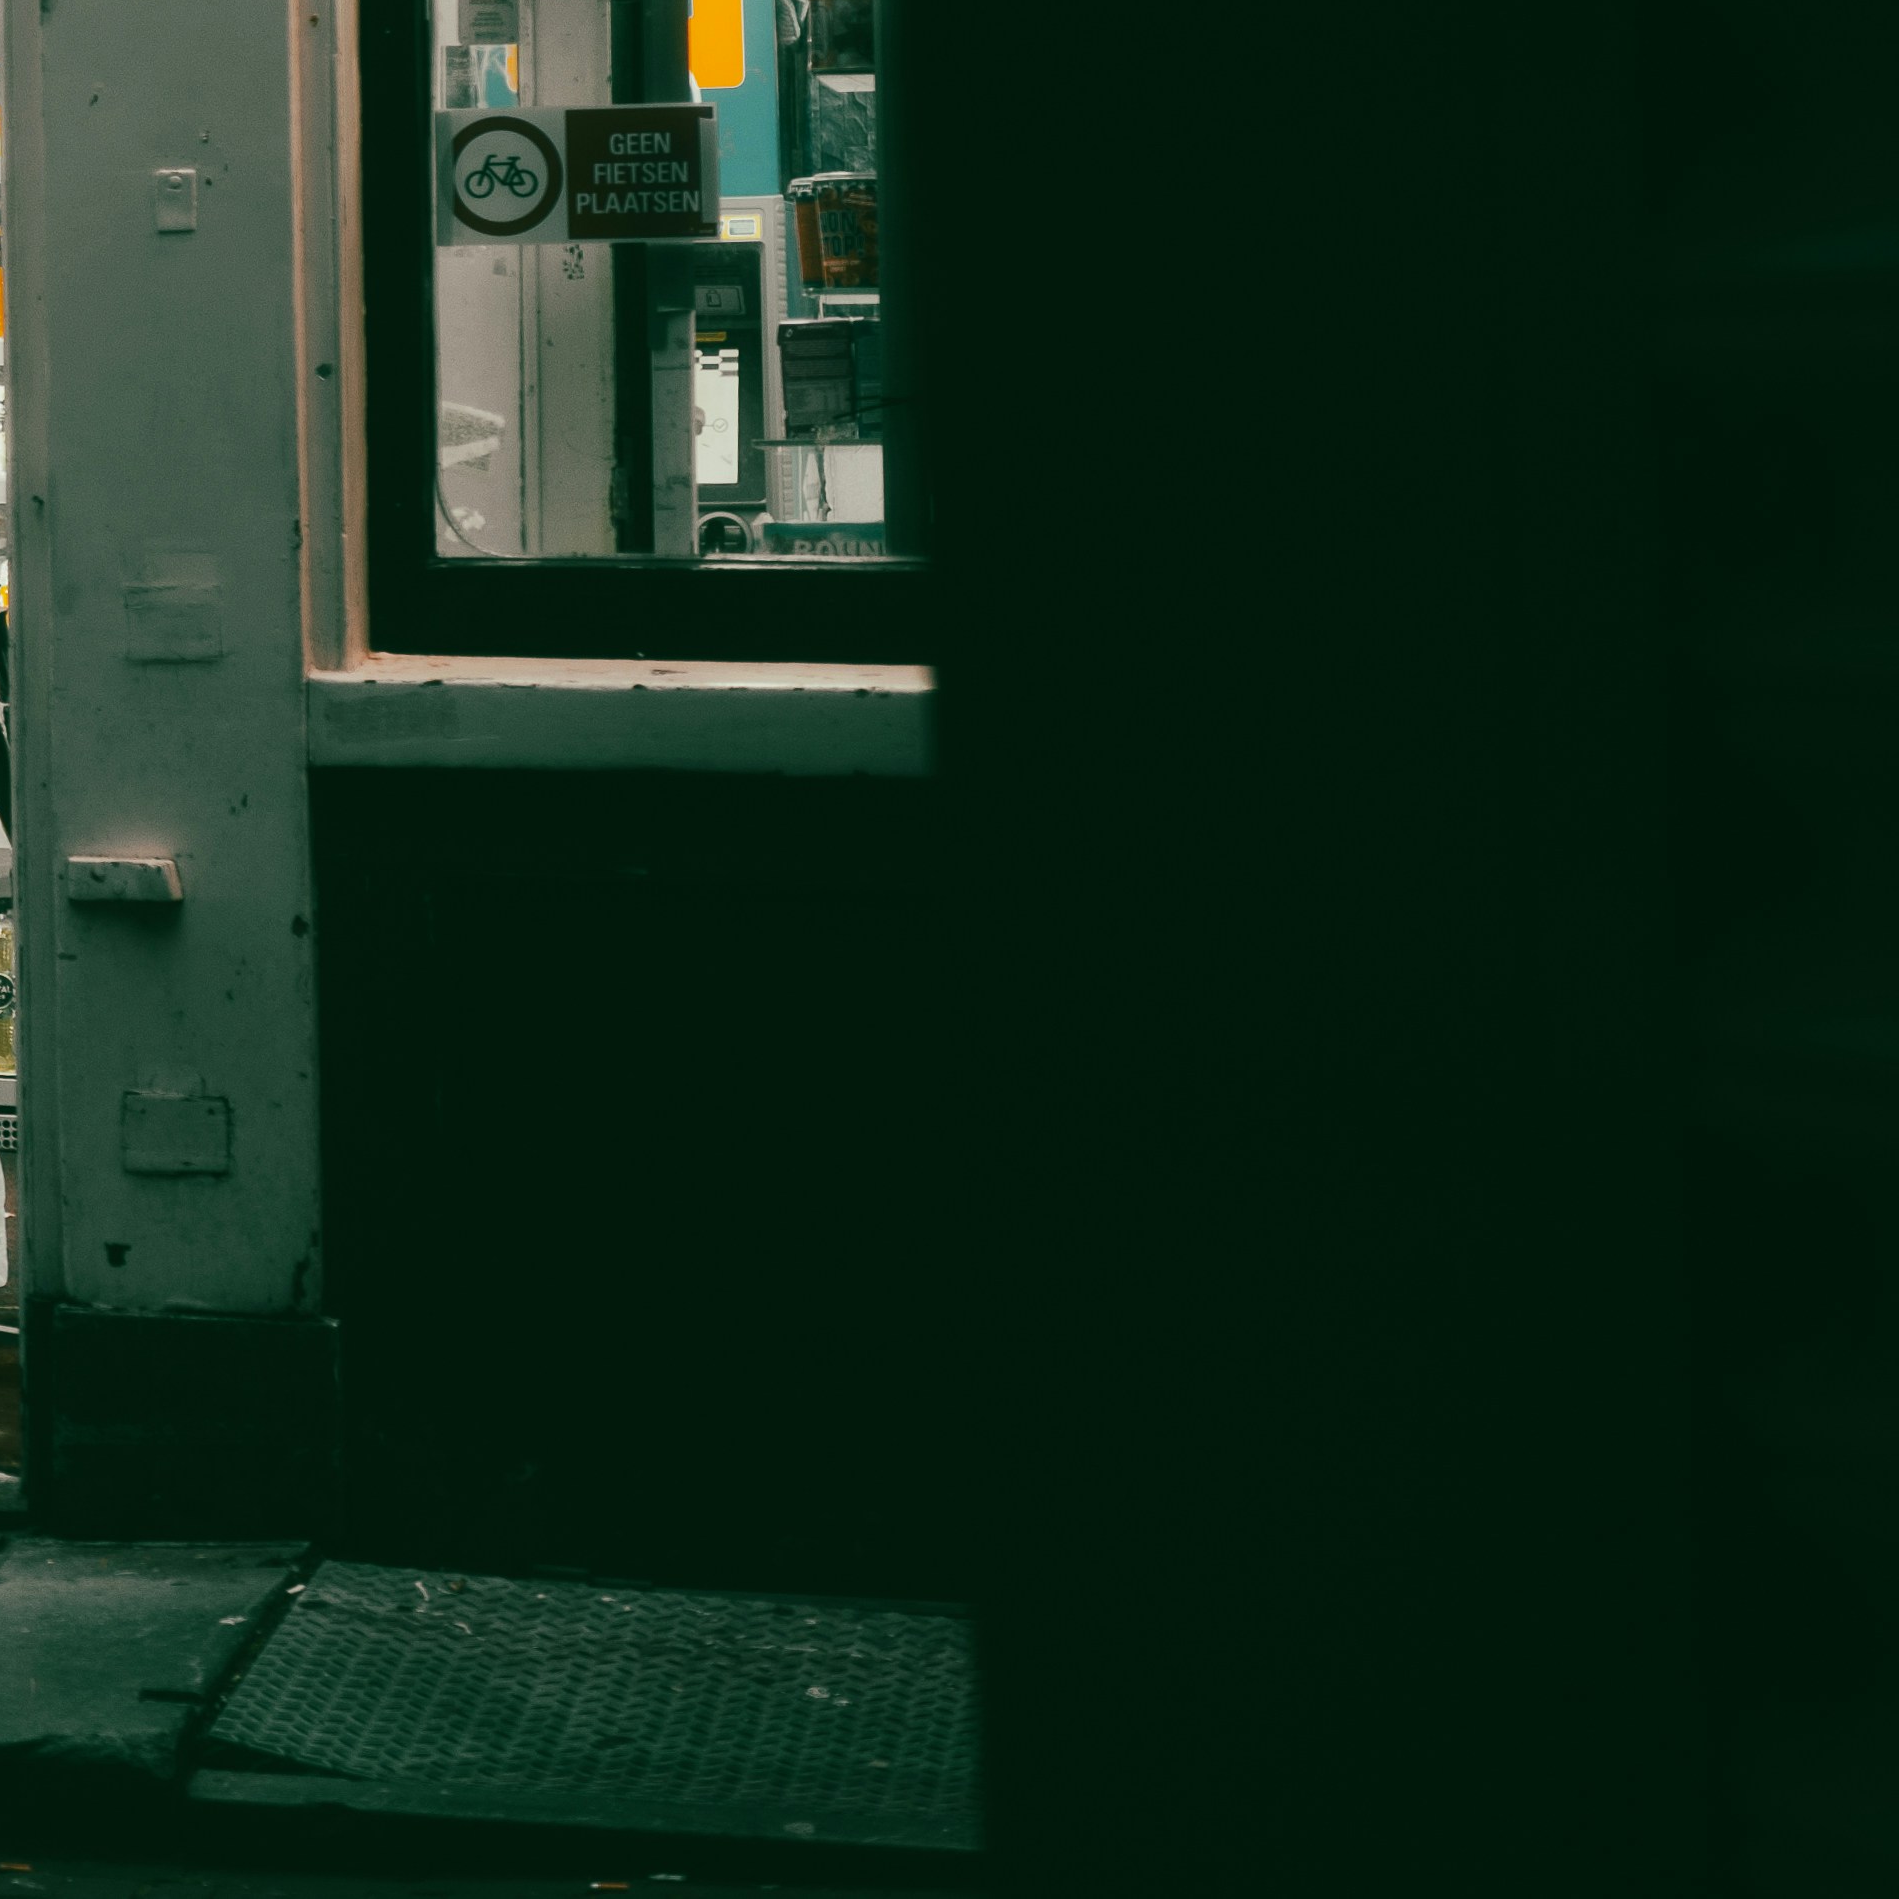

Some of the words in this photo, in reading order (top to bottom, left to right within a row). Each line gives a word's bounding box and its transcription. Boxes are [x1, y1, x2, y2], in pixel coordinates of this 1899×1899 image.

[609, 132, 671, 155] GEEN
[593, 162, 689, 185] FIETSEN
[575, 190, 701, 215] PLAATSEN
